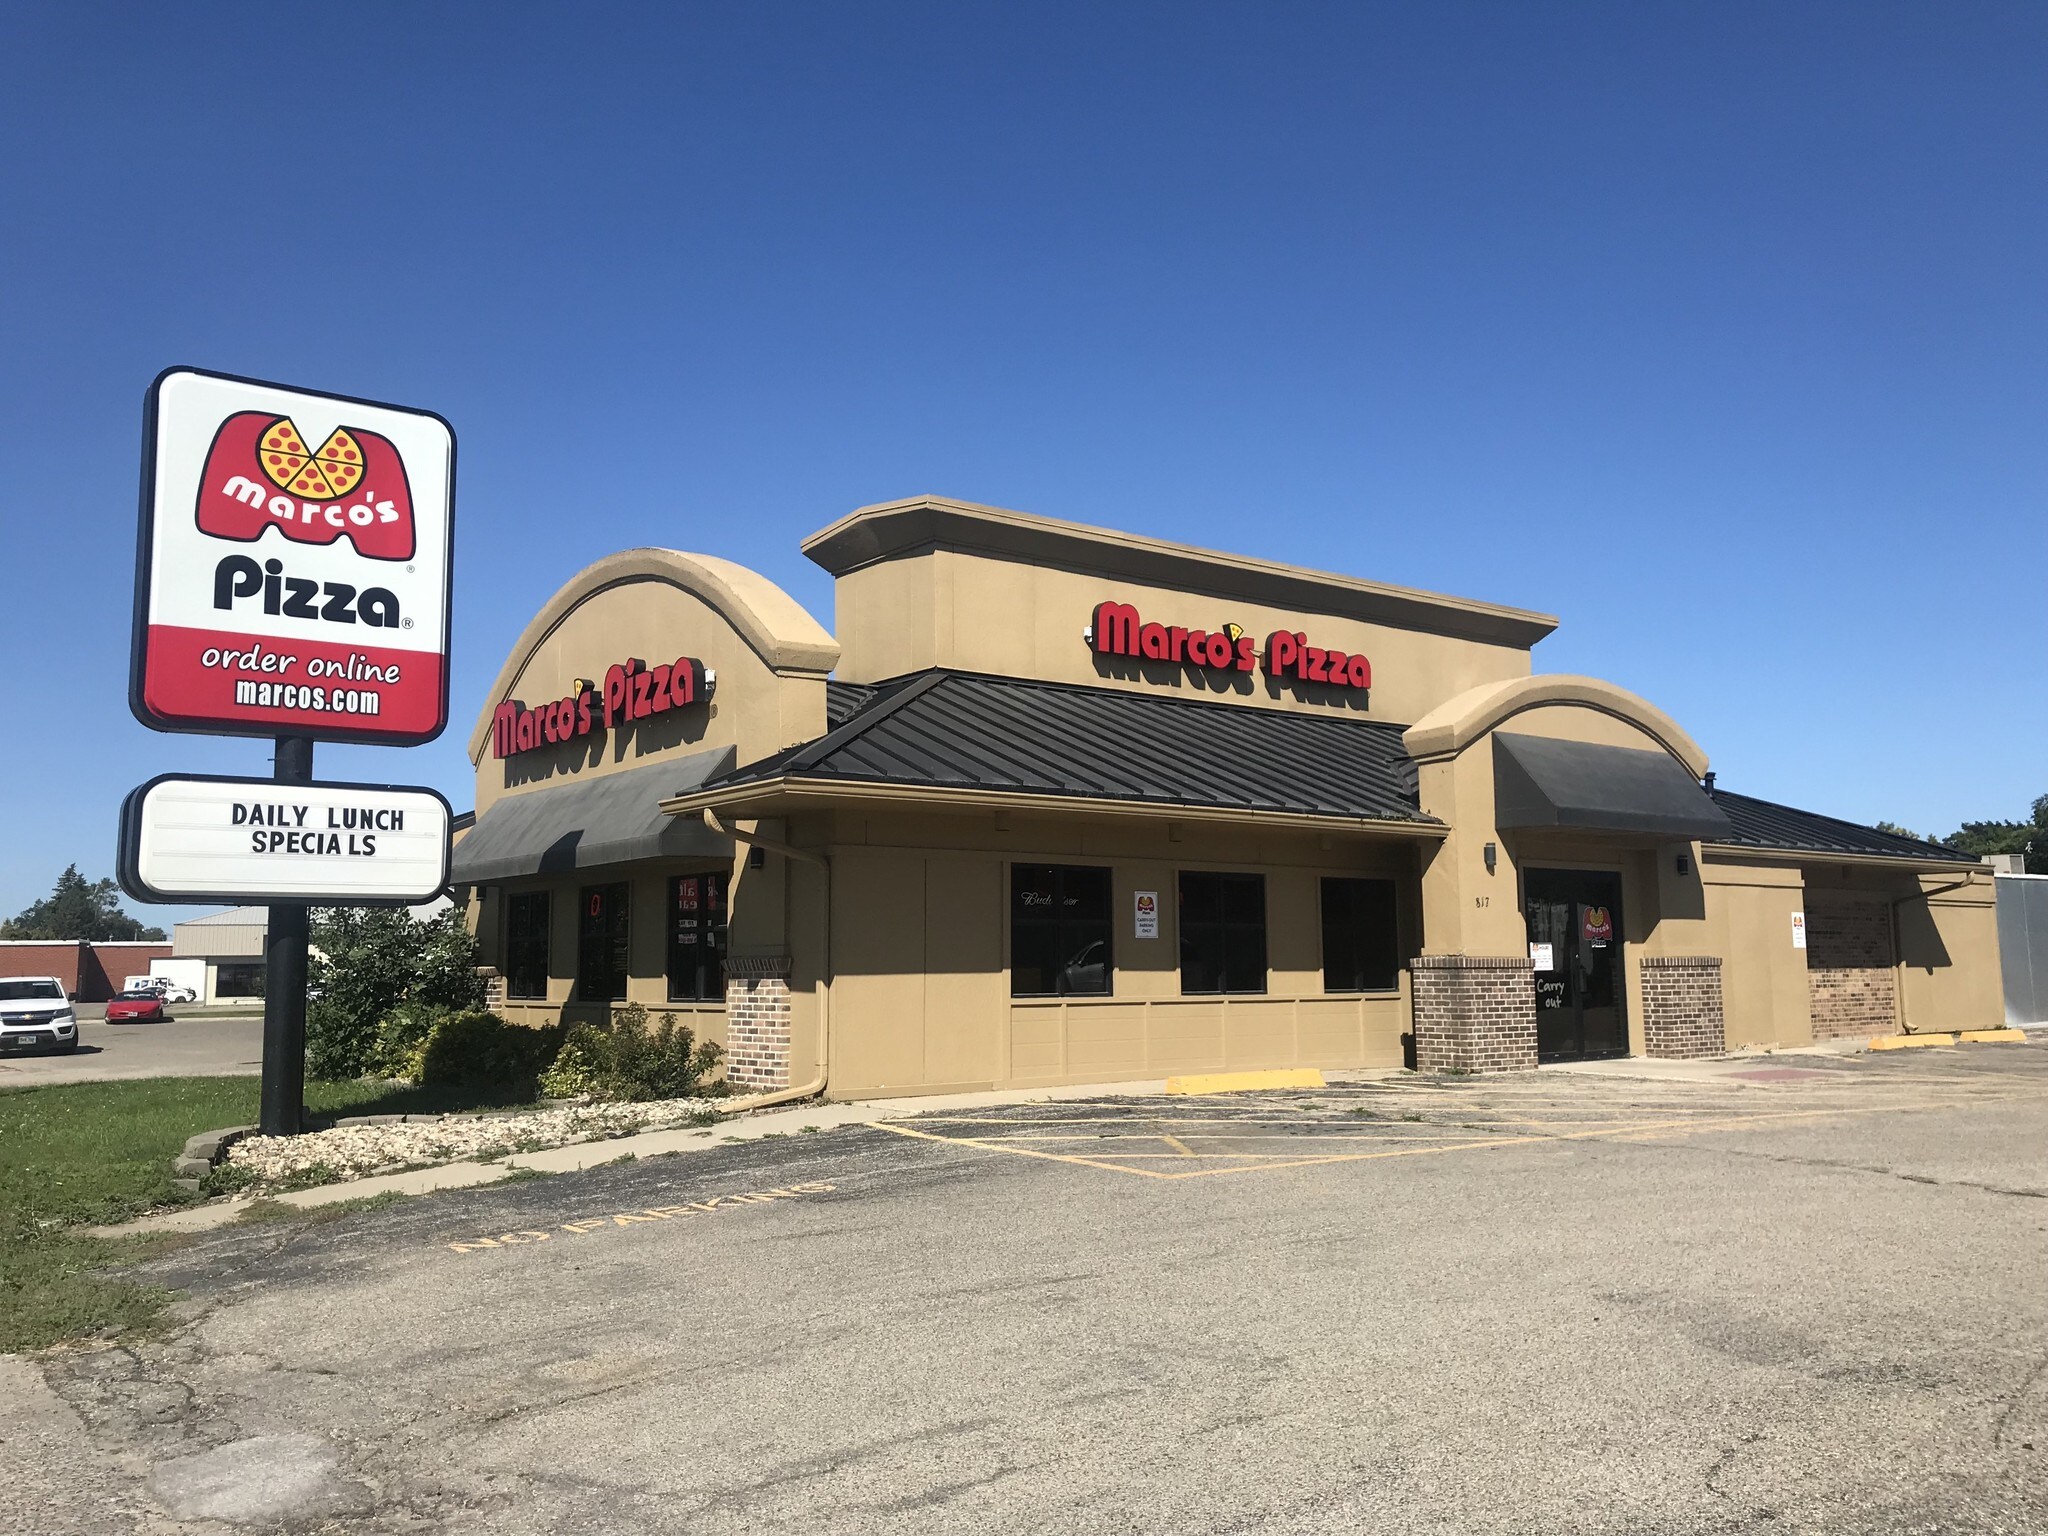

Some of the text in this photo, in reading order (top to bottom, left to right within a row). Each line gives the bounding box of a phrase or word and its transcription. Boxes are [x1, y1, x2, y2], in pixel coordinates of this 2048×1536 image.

[213, 554, 400, 629] Pizza
[1095, 601, 1371, 689] Marco's Pizza
[201, 643, 401, 684] order online
[235, 679, 380, 715] marcos.com
[494, 657, 698, 759] Marco's Pizza
[232, 803, 404, 830] DAILY LUNCH
[252, 830, 376, 856] SPECIALS
[1475, 897, 1489, 908] 817
[1536, 978, 1565, 995] Carry
[1545, 995, 1562, 1008] out
